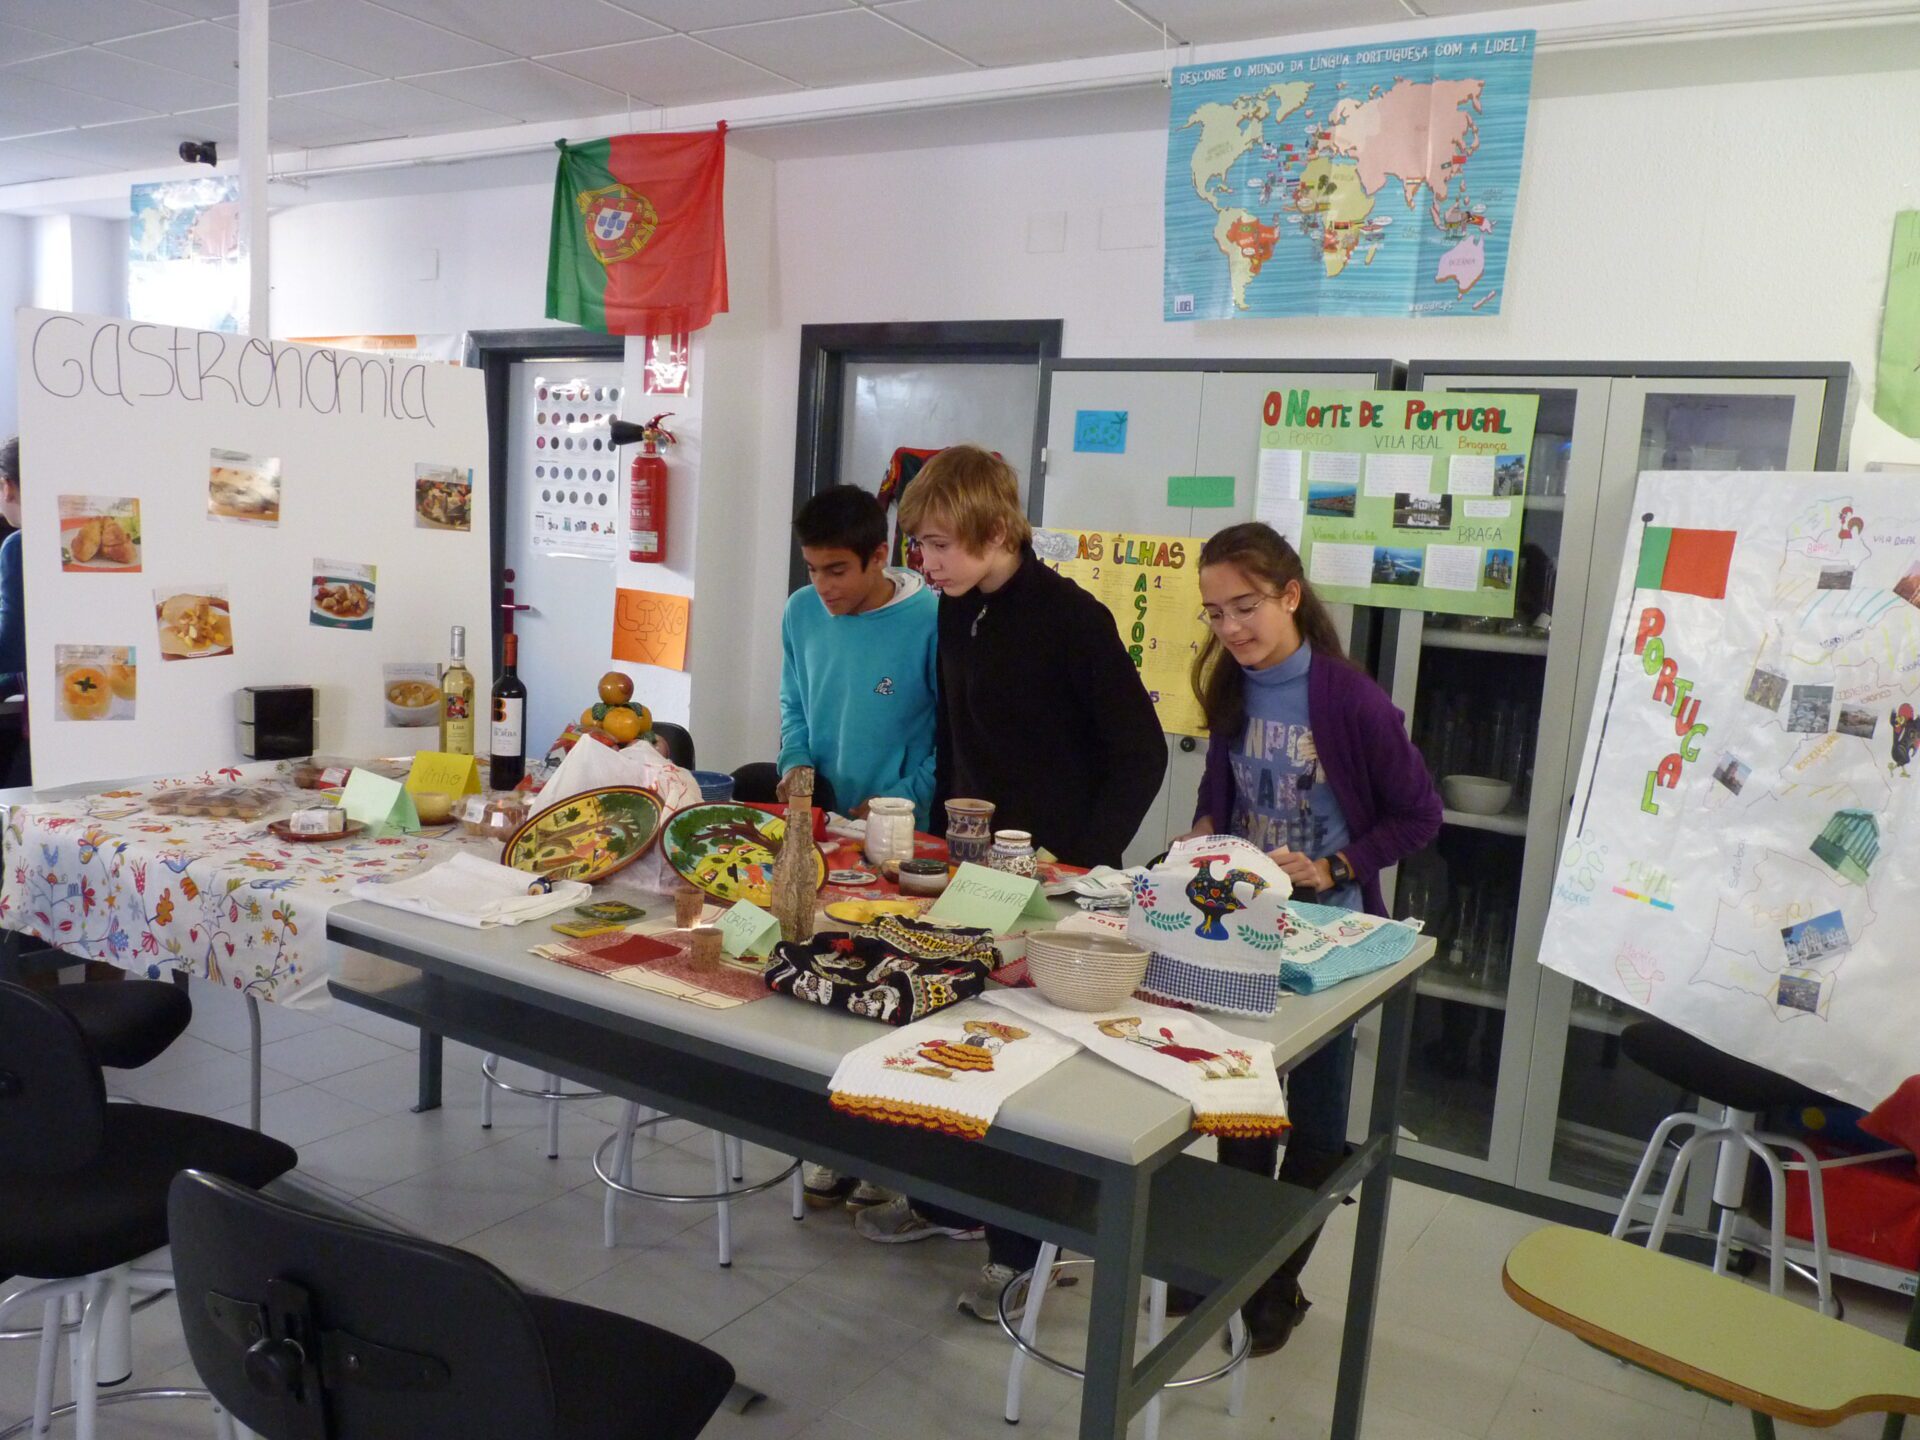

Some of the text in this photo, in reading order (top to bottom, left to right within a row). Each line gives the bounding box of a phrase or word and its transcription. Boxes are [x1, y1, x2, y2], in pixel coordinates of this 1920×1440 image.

[1180, 68, 1227, 85] DESCOBRE
[1234, 70, 1242, 80] O
[1247, 61, 1285, 77] MUNDO
[1290, 61, 1304, 73] DA
[1355, 46, 1429, 67] PORTUGUESA
[1435, 42, 1463, 57] COM
[1469, 44, 1479, 54] A
[1263, 391, 1282, 426] O
[1359, 400, 1384, 427] DE
[1374, 434, 1443, 450] VILA REAL
[1456, 526, 1502, 543] BRAGA
[1076, 534, 1104, 561] AS
[1153, 575, 1163, 589] 1
[616, 594, 687, 636] LIXO
[1149, 638, 1158, 650] 3
